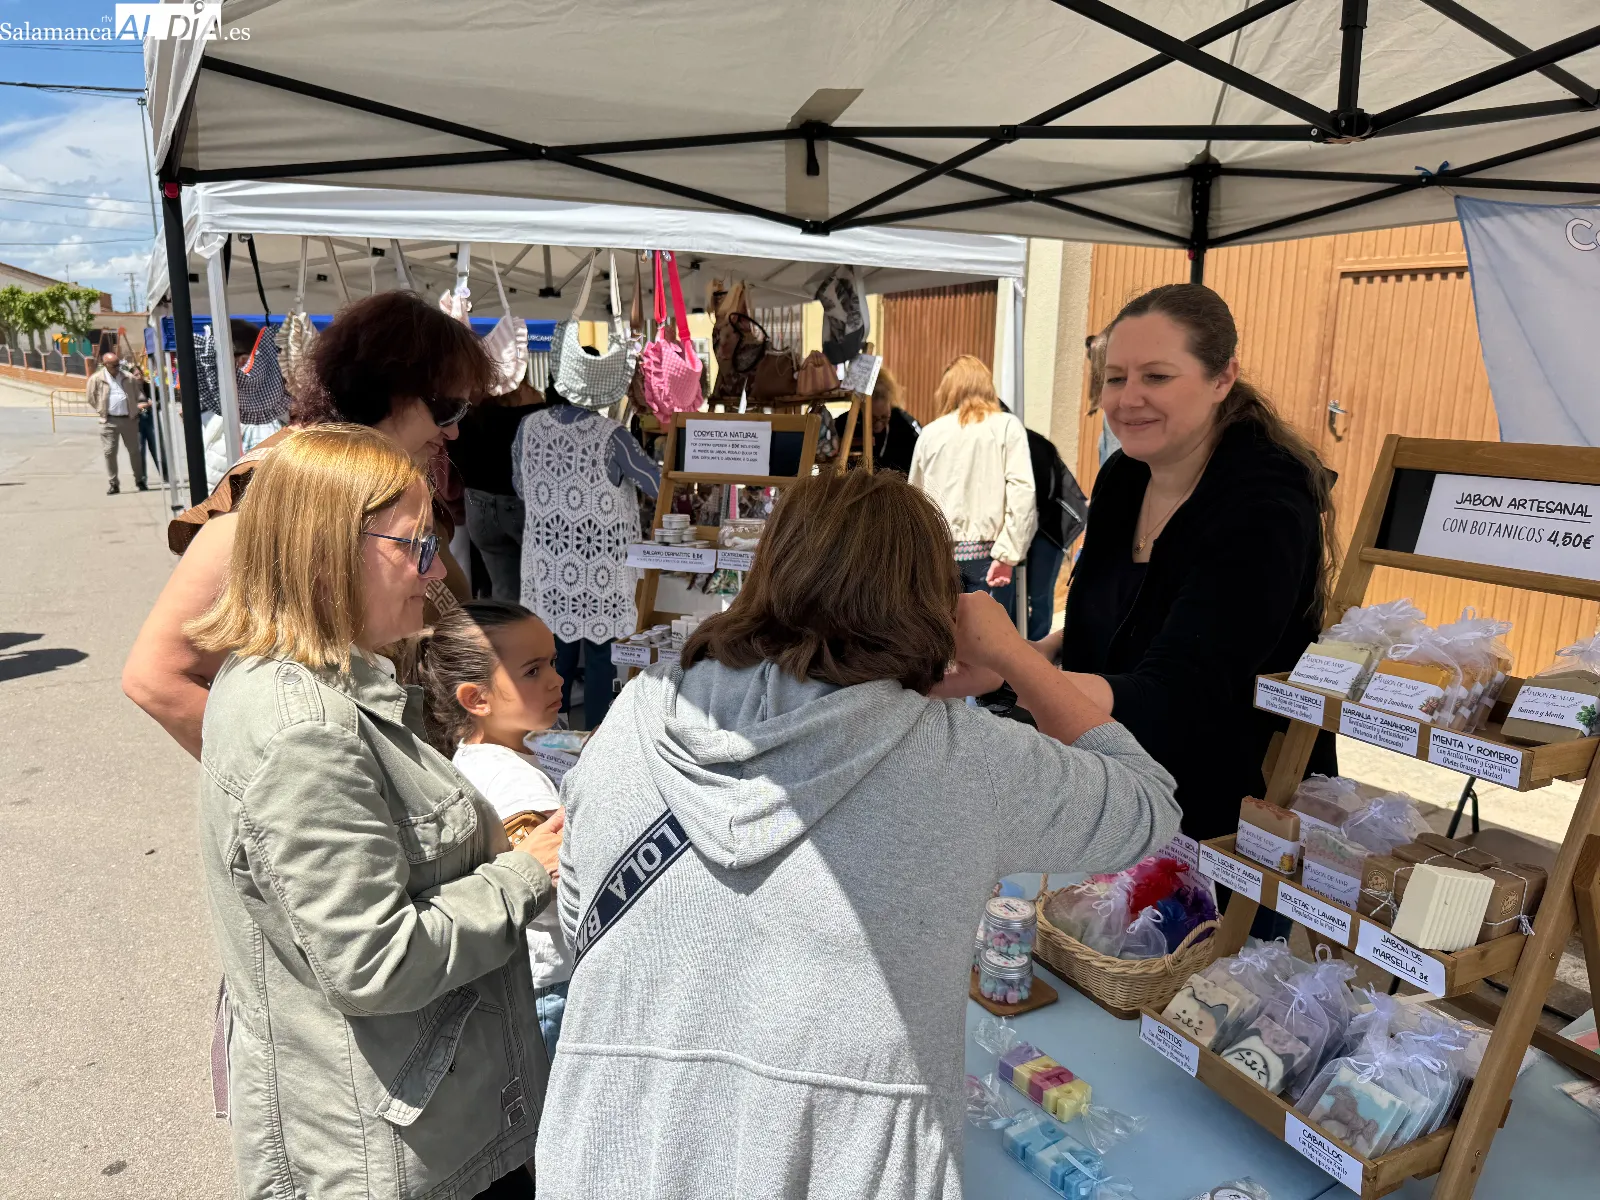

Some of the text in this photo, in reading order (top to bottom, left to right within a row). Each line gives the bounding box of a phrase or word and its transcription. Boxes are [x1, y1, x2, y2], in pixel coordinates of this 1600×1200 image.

[730, 431, 758, 439] NATURAL
[1456, 492, 1592, 518] JABON ARTESANAL
[1442, 517, 1594, 550] CON BOTANICOS 4,50€
[1259, 683, 1292, 696] MANZANILLA
[1300, 695, 1321, 706] NEROLI
[1343, 708, 1371, 720] NARANJA
[1380, 718, 1417, 734] ZANAHORIA
[1433, 734, 1463, 749] MENTA
[1477, 746, 1519, 764] ROMERO
[608, 823, 681, 902] LOLA
[1280, 891, 1309, 910] VIOLETAS
[1318, 909, 1346, 929] LAVANDA
[1372, 946, 1416, 974] MARSELLA
[1381, 935, 1422, 962] JABON DE
[1302, 1129, 1342, 1162] CABALLOS
